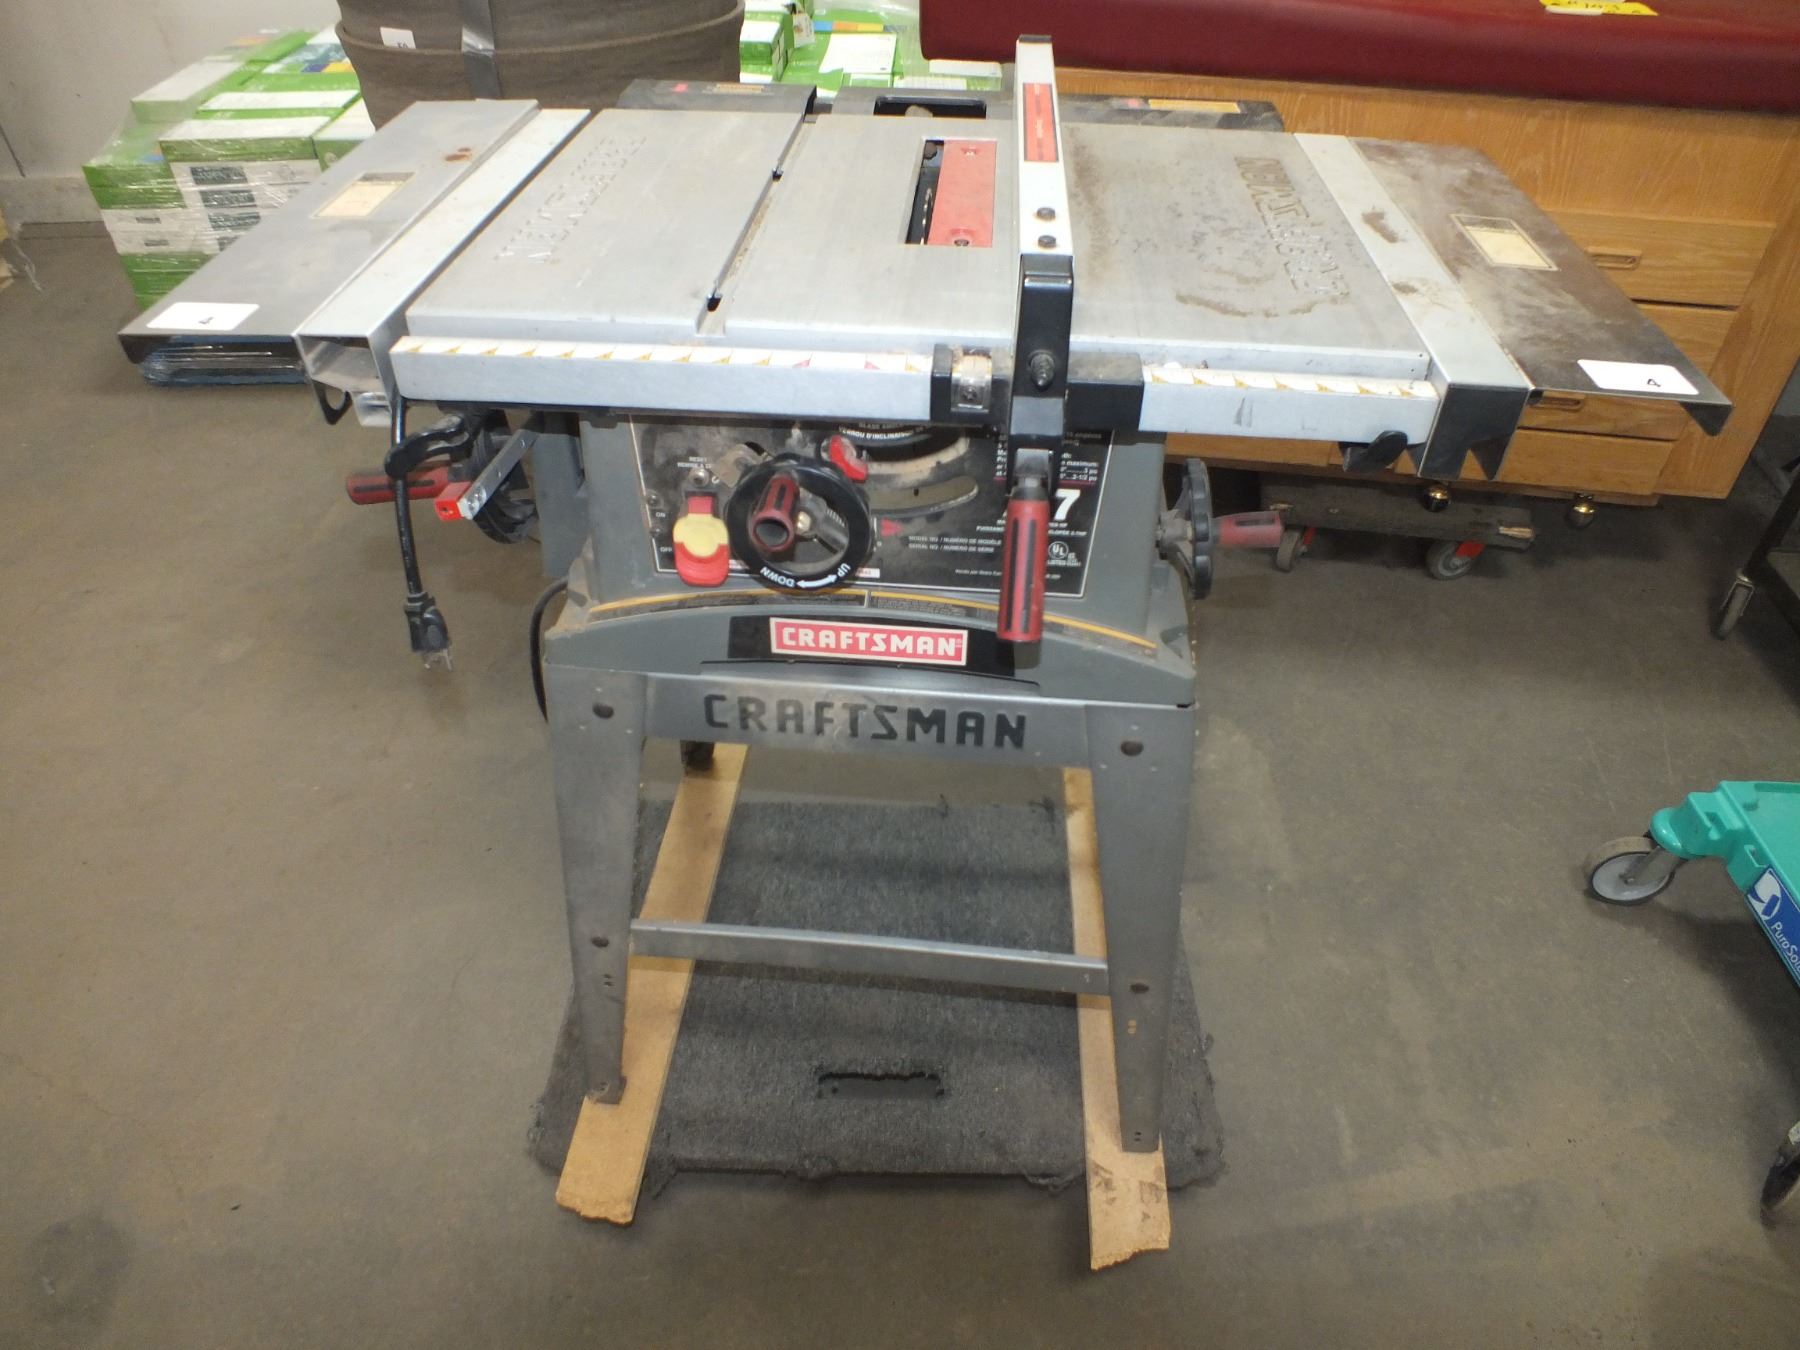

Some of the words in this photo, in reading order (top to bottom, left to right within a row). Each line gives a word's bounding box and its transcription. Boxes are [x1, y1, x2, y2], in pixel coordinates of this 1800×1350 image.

[760, 566, 797, 588] DOWN
[837, 563, 852, 578] UP
[703, 694, 1027, 750] CRAFTSMAN
